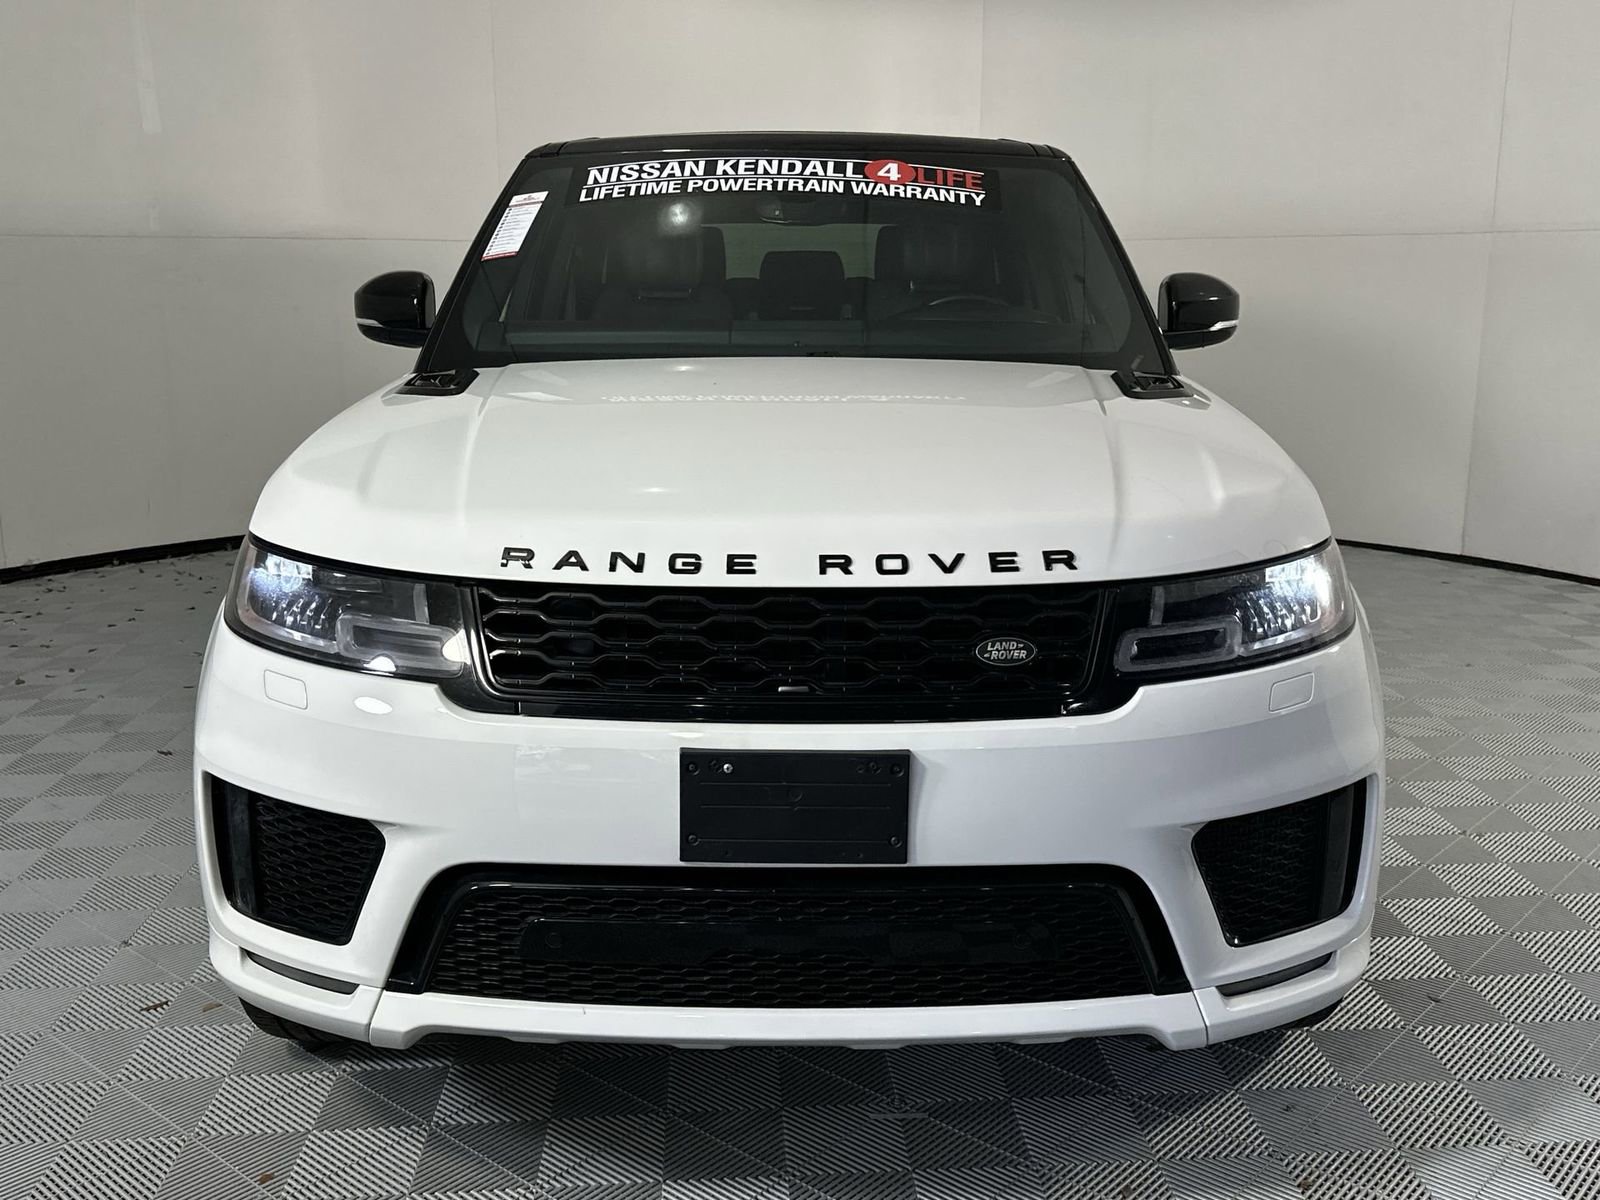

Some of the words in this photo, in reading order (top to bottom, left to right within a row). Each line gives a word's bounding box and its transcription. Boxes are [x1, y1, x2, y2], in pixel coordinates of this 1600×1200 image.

[586, 159, 706, 186] NISSAN
[716, 158, 864, 178] KENDALL
[876, 162, 902, 182] 4
[917, 167, 984, 190] LIFE
[579, 180, 682, 202] LIFETIME
[687, 177, 845, 194] POWERTRAIN
[850, 181, 986, 207] WARRANTY
[500, 546, 758, 575] RANGE
[818, 549, 1079, 576] ROVER
[990, 650, 1028, 660] ROVER
